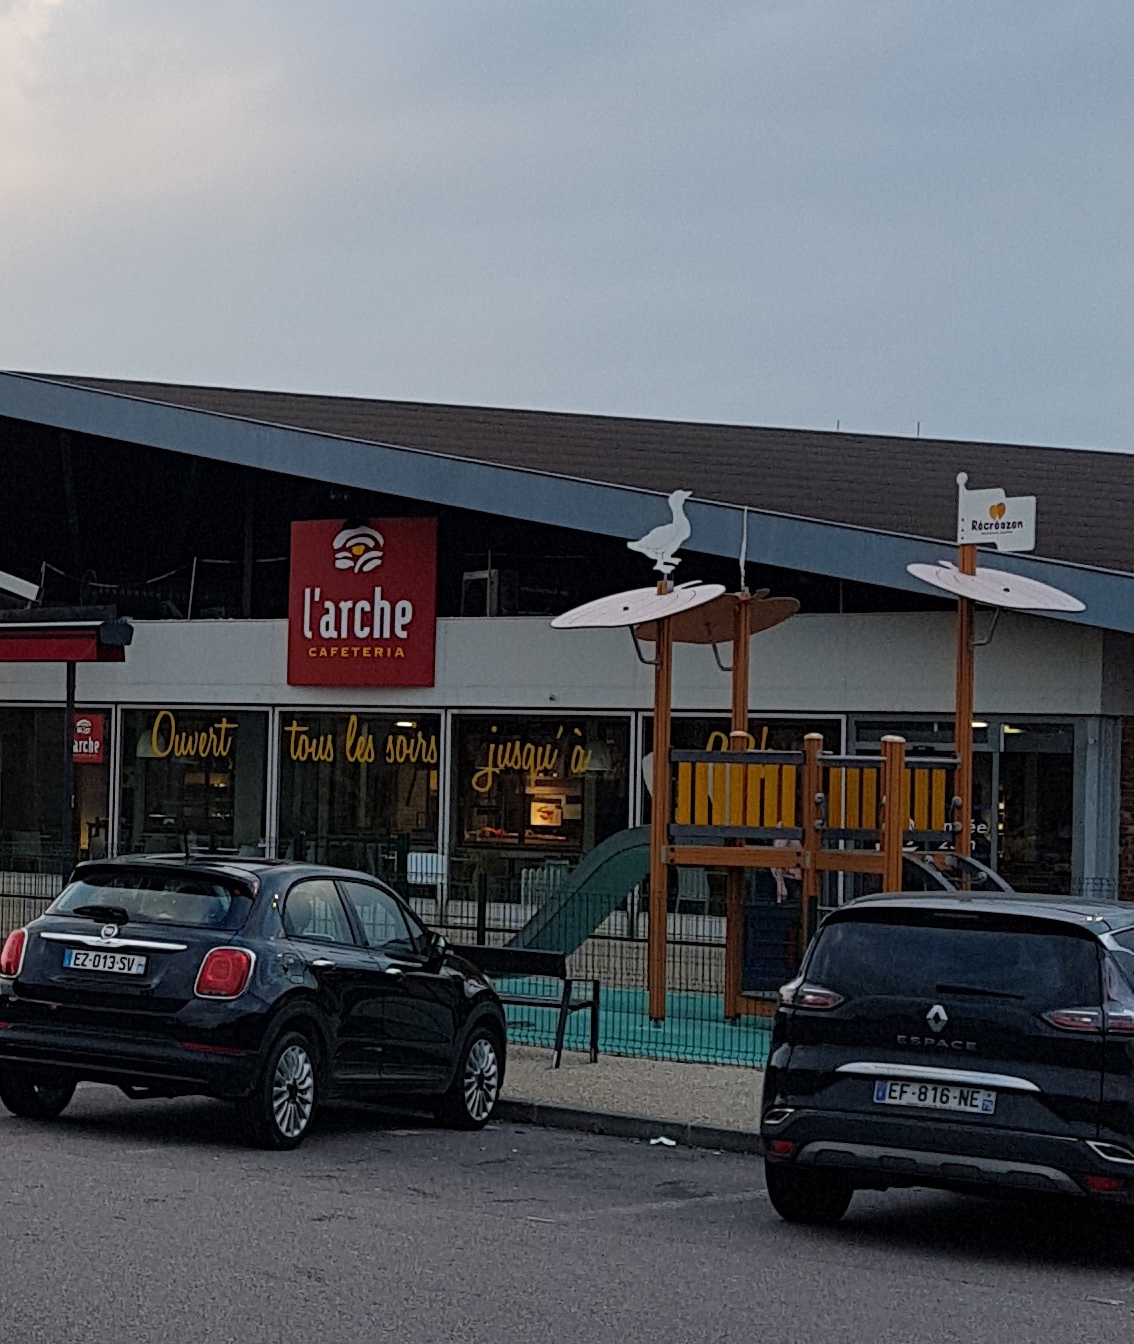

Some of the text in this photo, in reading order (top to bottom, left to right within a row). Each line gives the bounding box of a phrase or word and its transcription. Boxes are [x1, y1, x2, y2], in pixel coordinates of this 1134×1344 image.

[303, 586, 413, 639] l'arche
[308, 646, 406, 659] CAFETERIA
[151, 710, 239, 758] Ouvert
[283, 719, 334, 763] tous
[345, 713, 376, 763] les
[385, 730, 438, 764] soirs
[897, 1034, 977, 1051] ESPACE
[888, 1082, 981, 1107] EF-816-NE
